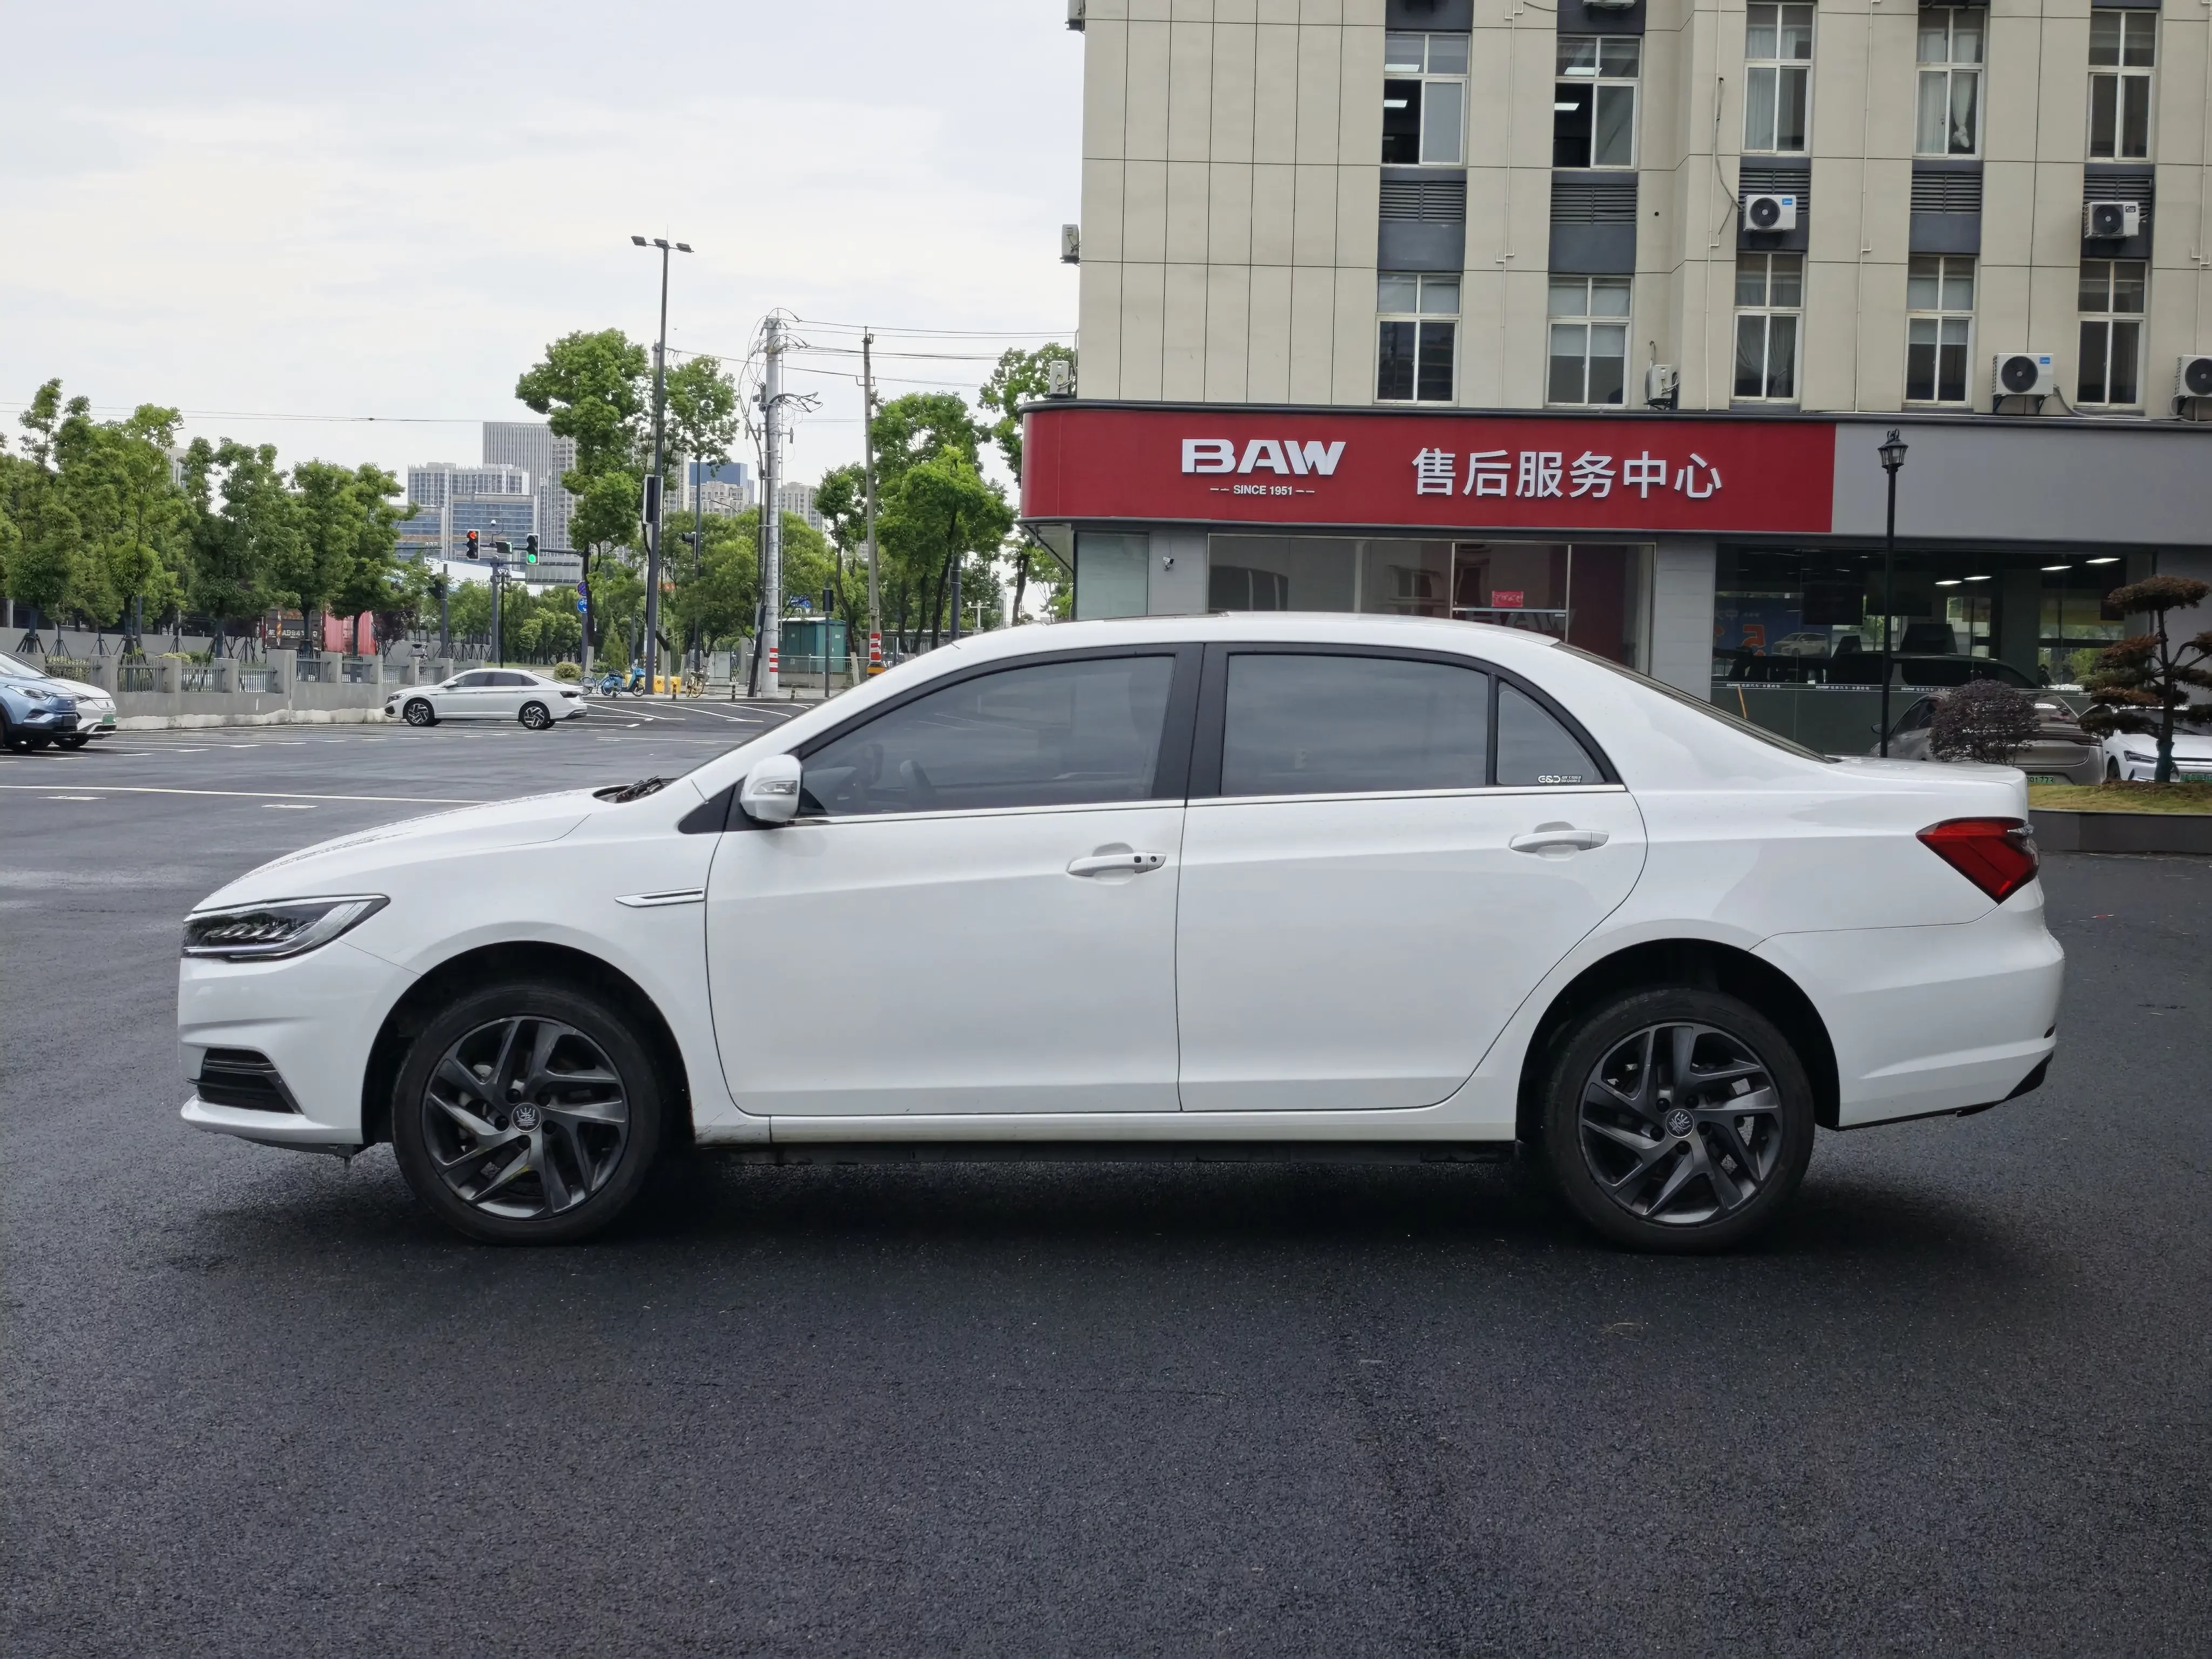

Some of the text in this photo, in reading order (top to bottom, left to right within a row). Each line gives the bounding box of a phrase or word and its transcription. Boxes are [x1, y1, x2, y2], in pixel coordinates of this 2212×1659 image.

[1182, 439, 1346, 475] BAW
[1412, 448, 1721, 498] 售后服务中心
[1234, 485, 1292, 495] SINCE 1951
